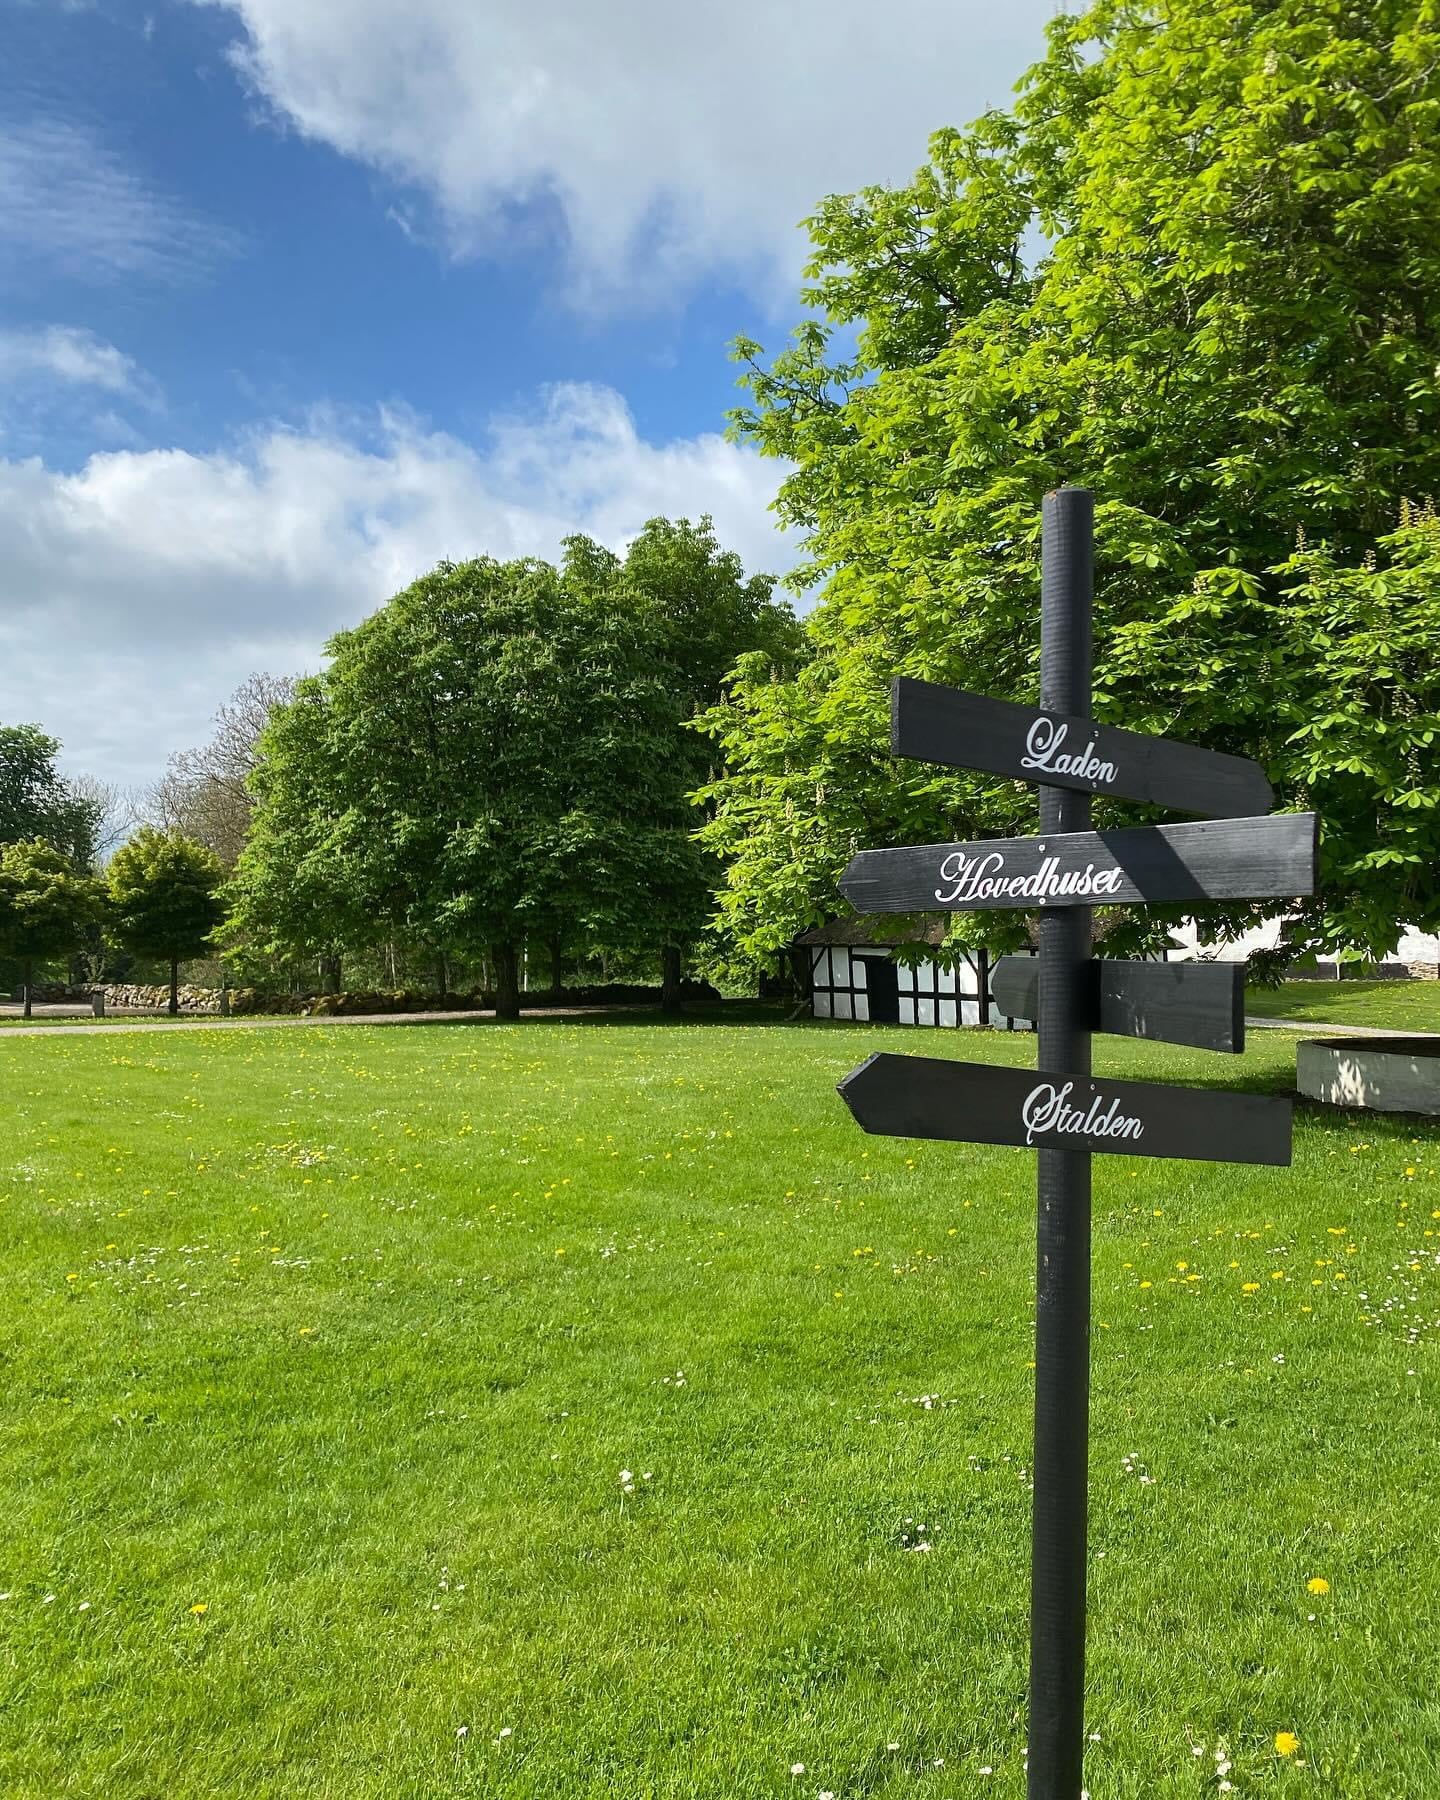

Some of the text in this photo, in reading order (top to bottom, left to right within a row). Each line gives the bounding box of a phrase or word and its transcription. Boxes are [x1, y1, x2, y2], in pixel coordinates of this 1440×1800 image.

[1020, 716, 1118, 783] Laden
[934, 852, 1124, 903] Hovedhuset
[1022, 1082, 1144, 1145] Stalden
